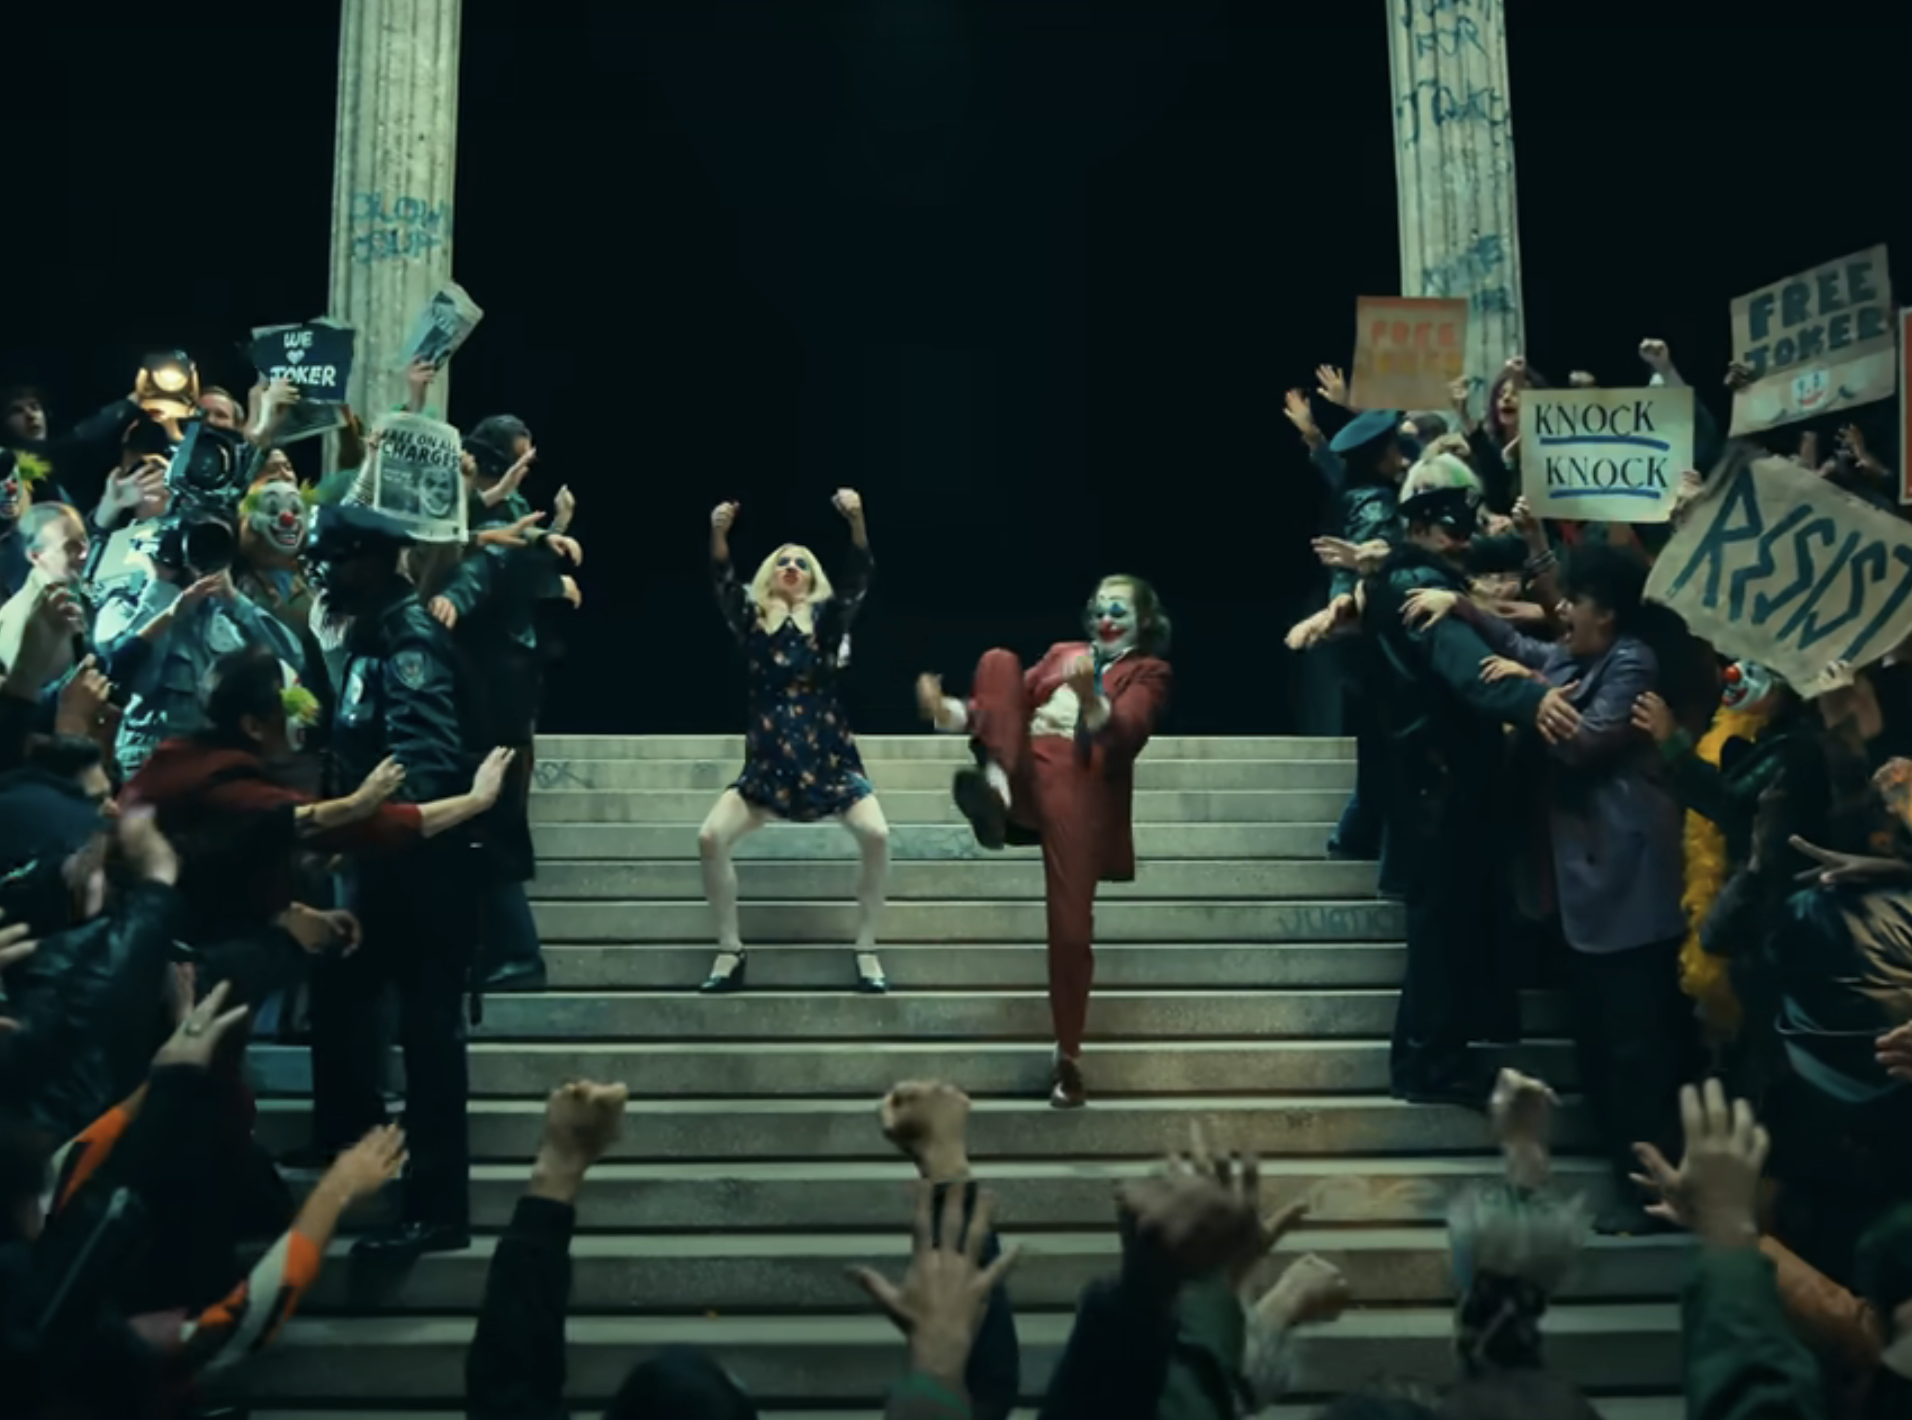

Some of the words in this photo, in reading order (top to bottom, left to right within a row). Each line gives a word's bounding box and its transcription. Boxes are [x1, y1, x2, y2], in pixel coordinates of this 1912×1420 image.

[1749, 262, 1877, 342] FREE
[283, 331, 314, 349] WE
[1744, 306, 1888, 378] JOKER
[270, 365, 337, 387] JOKER
[1535, 401, 1656, 436] KNOCK
[1546, 456, 1669, 489] KNOCK
[1666, 464, 1912, 663] RESIST
